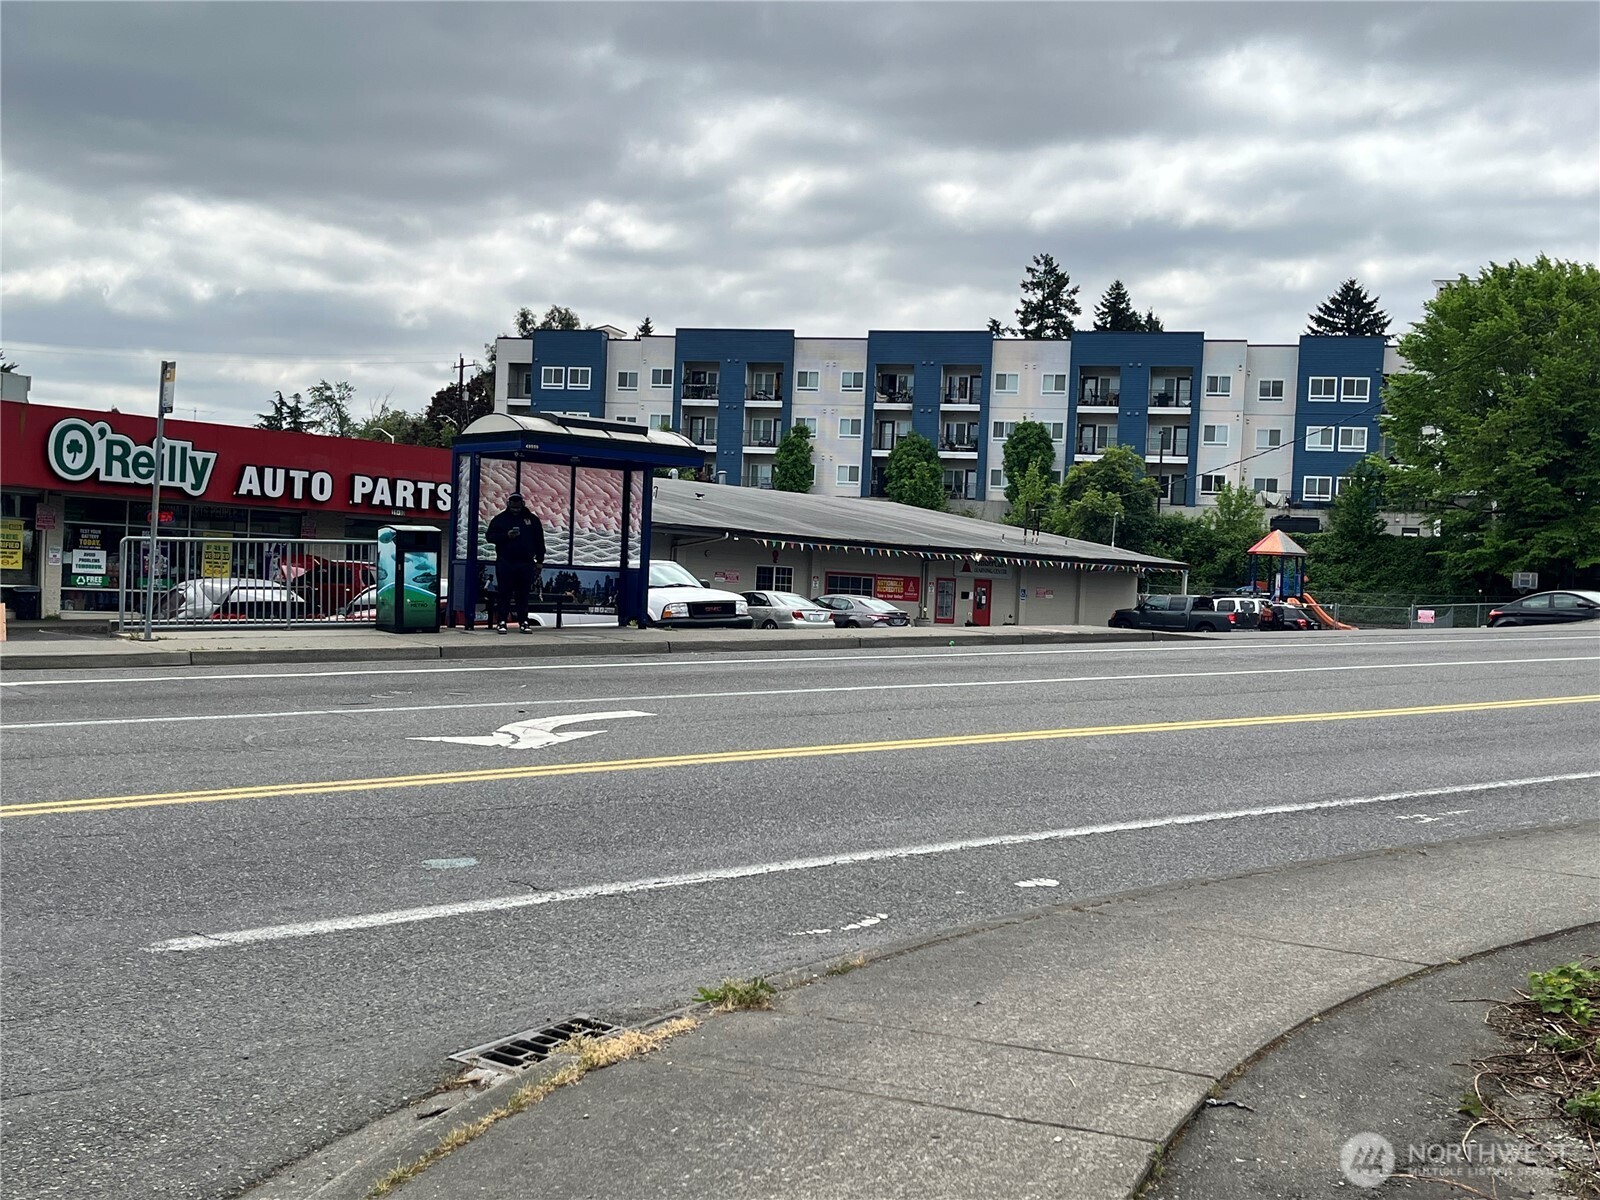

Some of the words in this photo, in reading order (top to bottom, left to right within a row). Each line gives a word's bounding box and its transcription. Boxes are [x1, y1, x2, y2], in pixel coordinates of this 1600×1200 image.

[53, 423, 211, 491] O'Reilly
[238, 465, 333, 502] AUTO
[353, 475, 452, 512] PARTS
[147, 511, 174, 523] OEN
[79, 539, 102, 547] TODAY.
[86, 575, 103, 583] FREE
